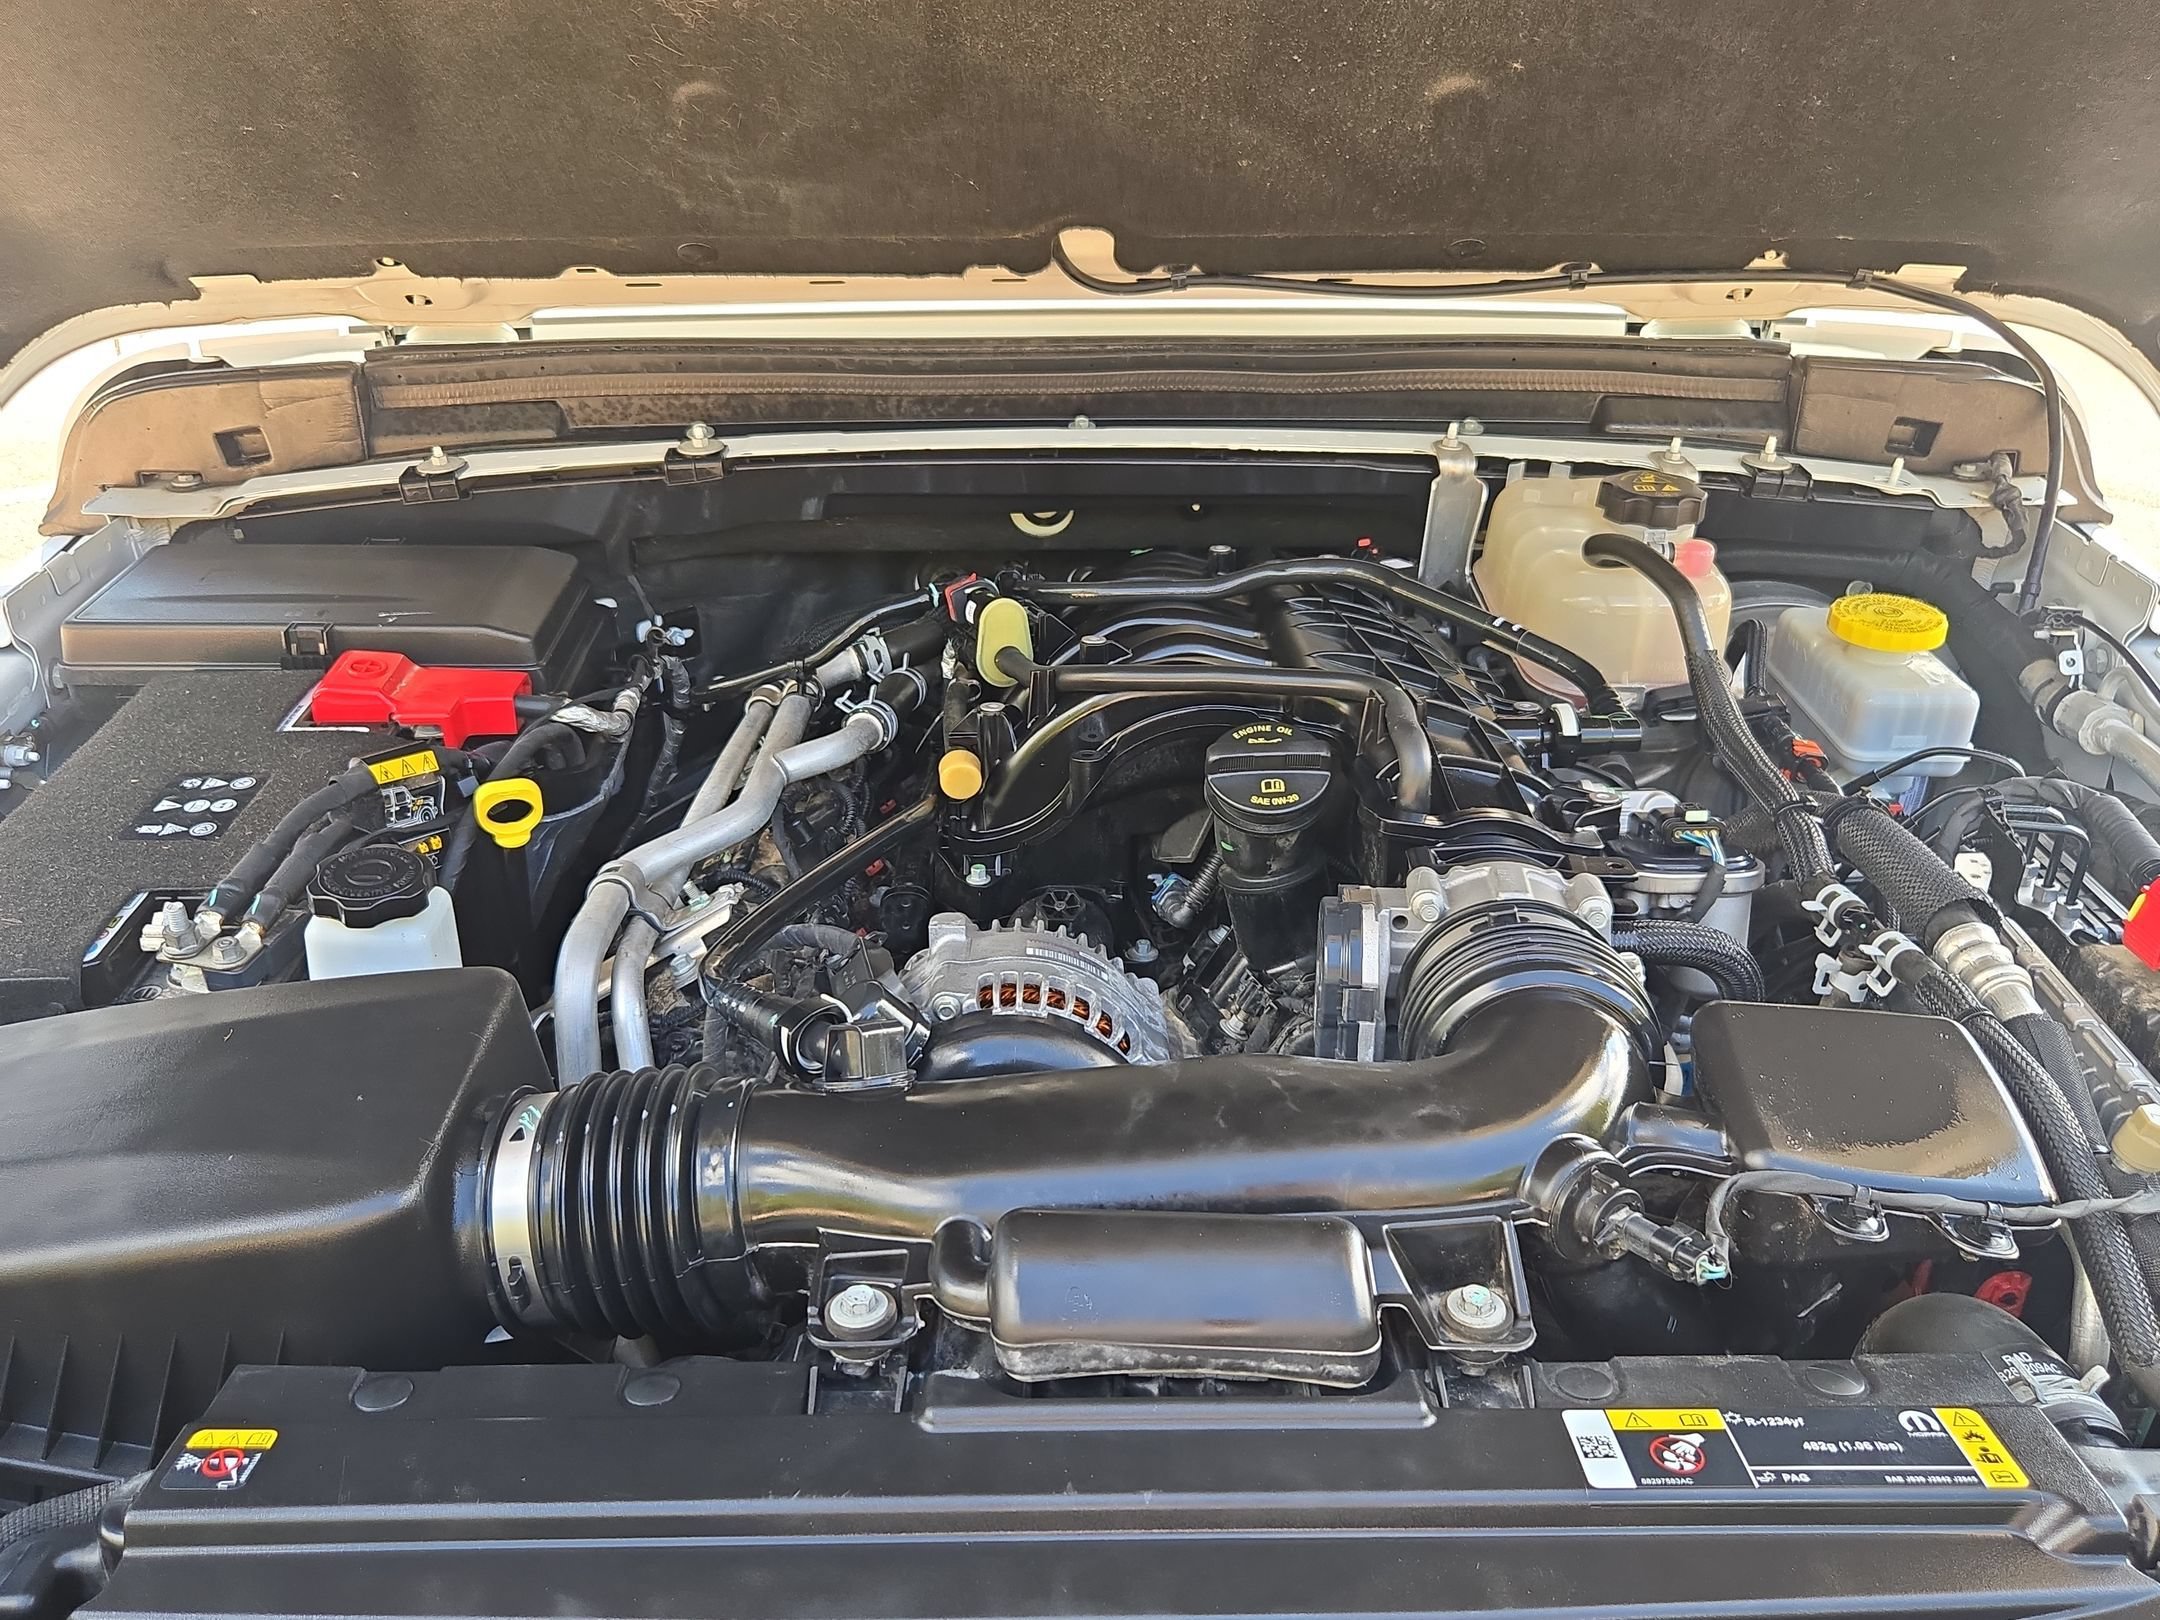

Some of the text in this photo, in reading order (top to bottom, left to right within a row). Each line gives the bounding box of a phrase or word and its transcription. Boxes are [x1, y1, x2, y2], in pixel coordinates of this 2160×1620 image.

[1231, 724, 1294, 740] ENGINE OIL
[1250, 793, 1300, 806] SAE 0W-20
[2001, 1351, 2033, 1367] RAD
[1744, 1416, 1805, 1428] R-1234yf
[1781, 1473, 1811, 1483] PAG
